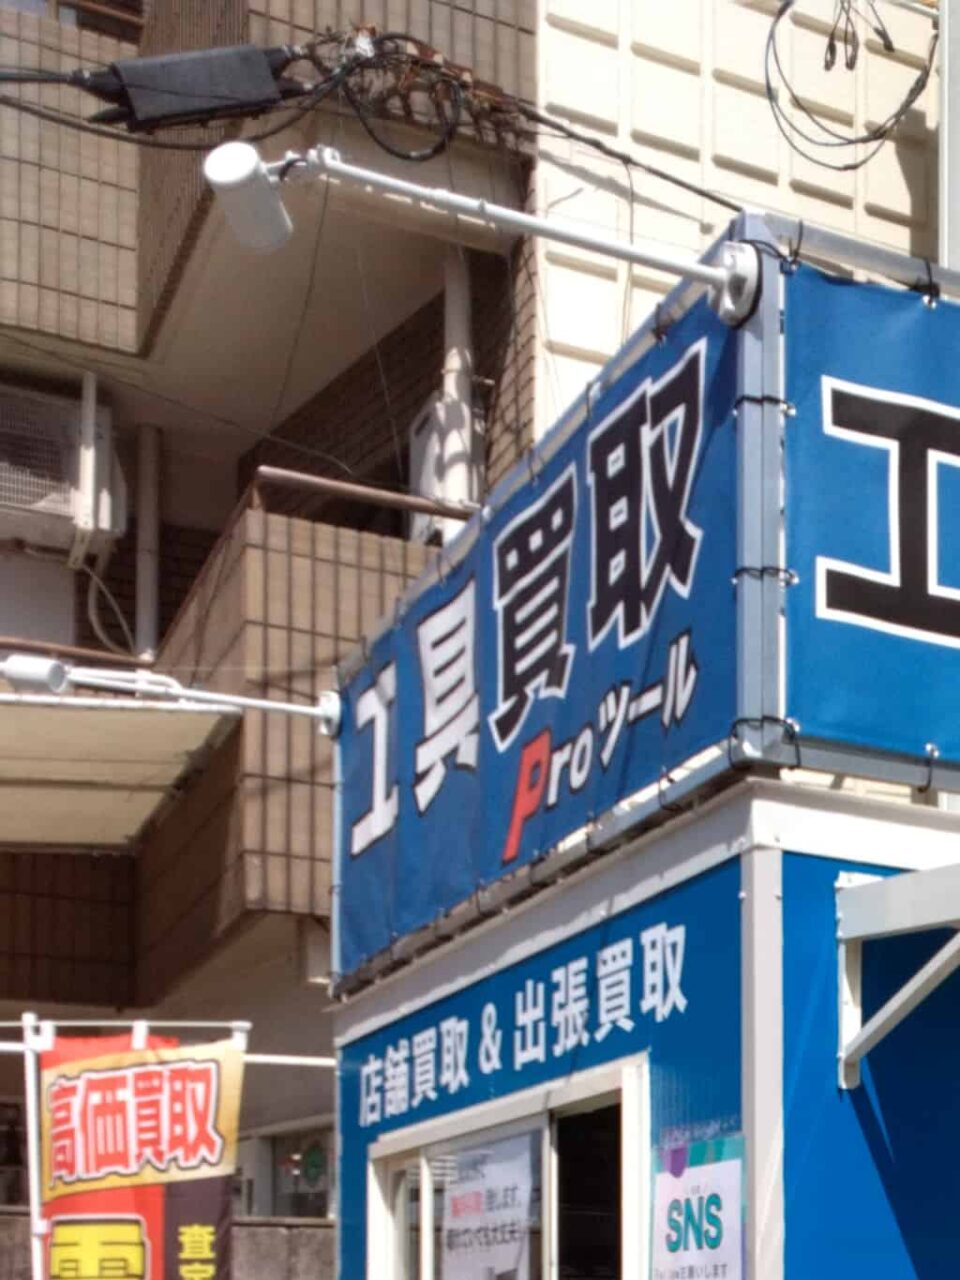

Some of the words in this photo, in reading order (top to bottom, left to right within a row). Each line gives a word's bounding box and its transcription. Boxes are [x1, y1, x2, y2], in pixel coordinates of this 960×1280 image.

[350, 337, 708, 858] 工具買取
[502, 629, 699, 862] Proツール
[50, 1059, 224, 1188] 高価買取
[665, 1193, 723, 1253] SNS
